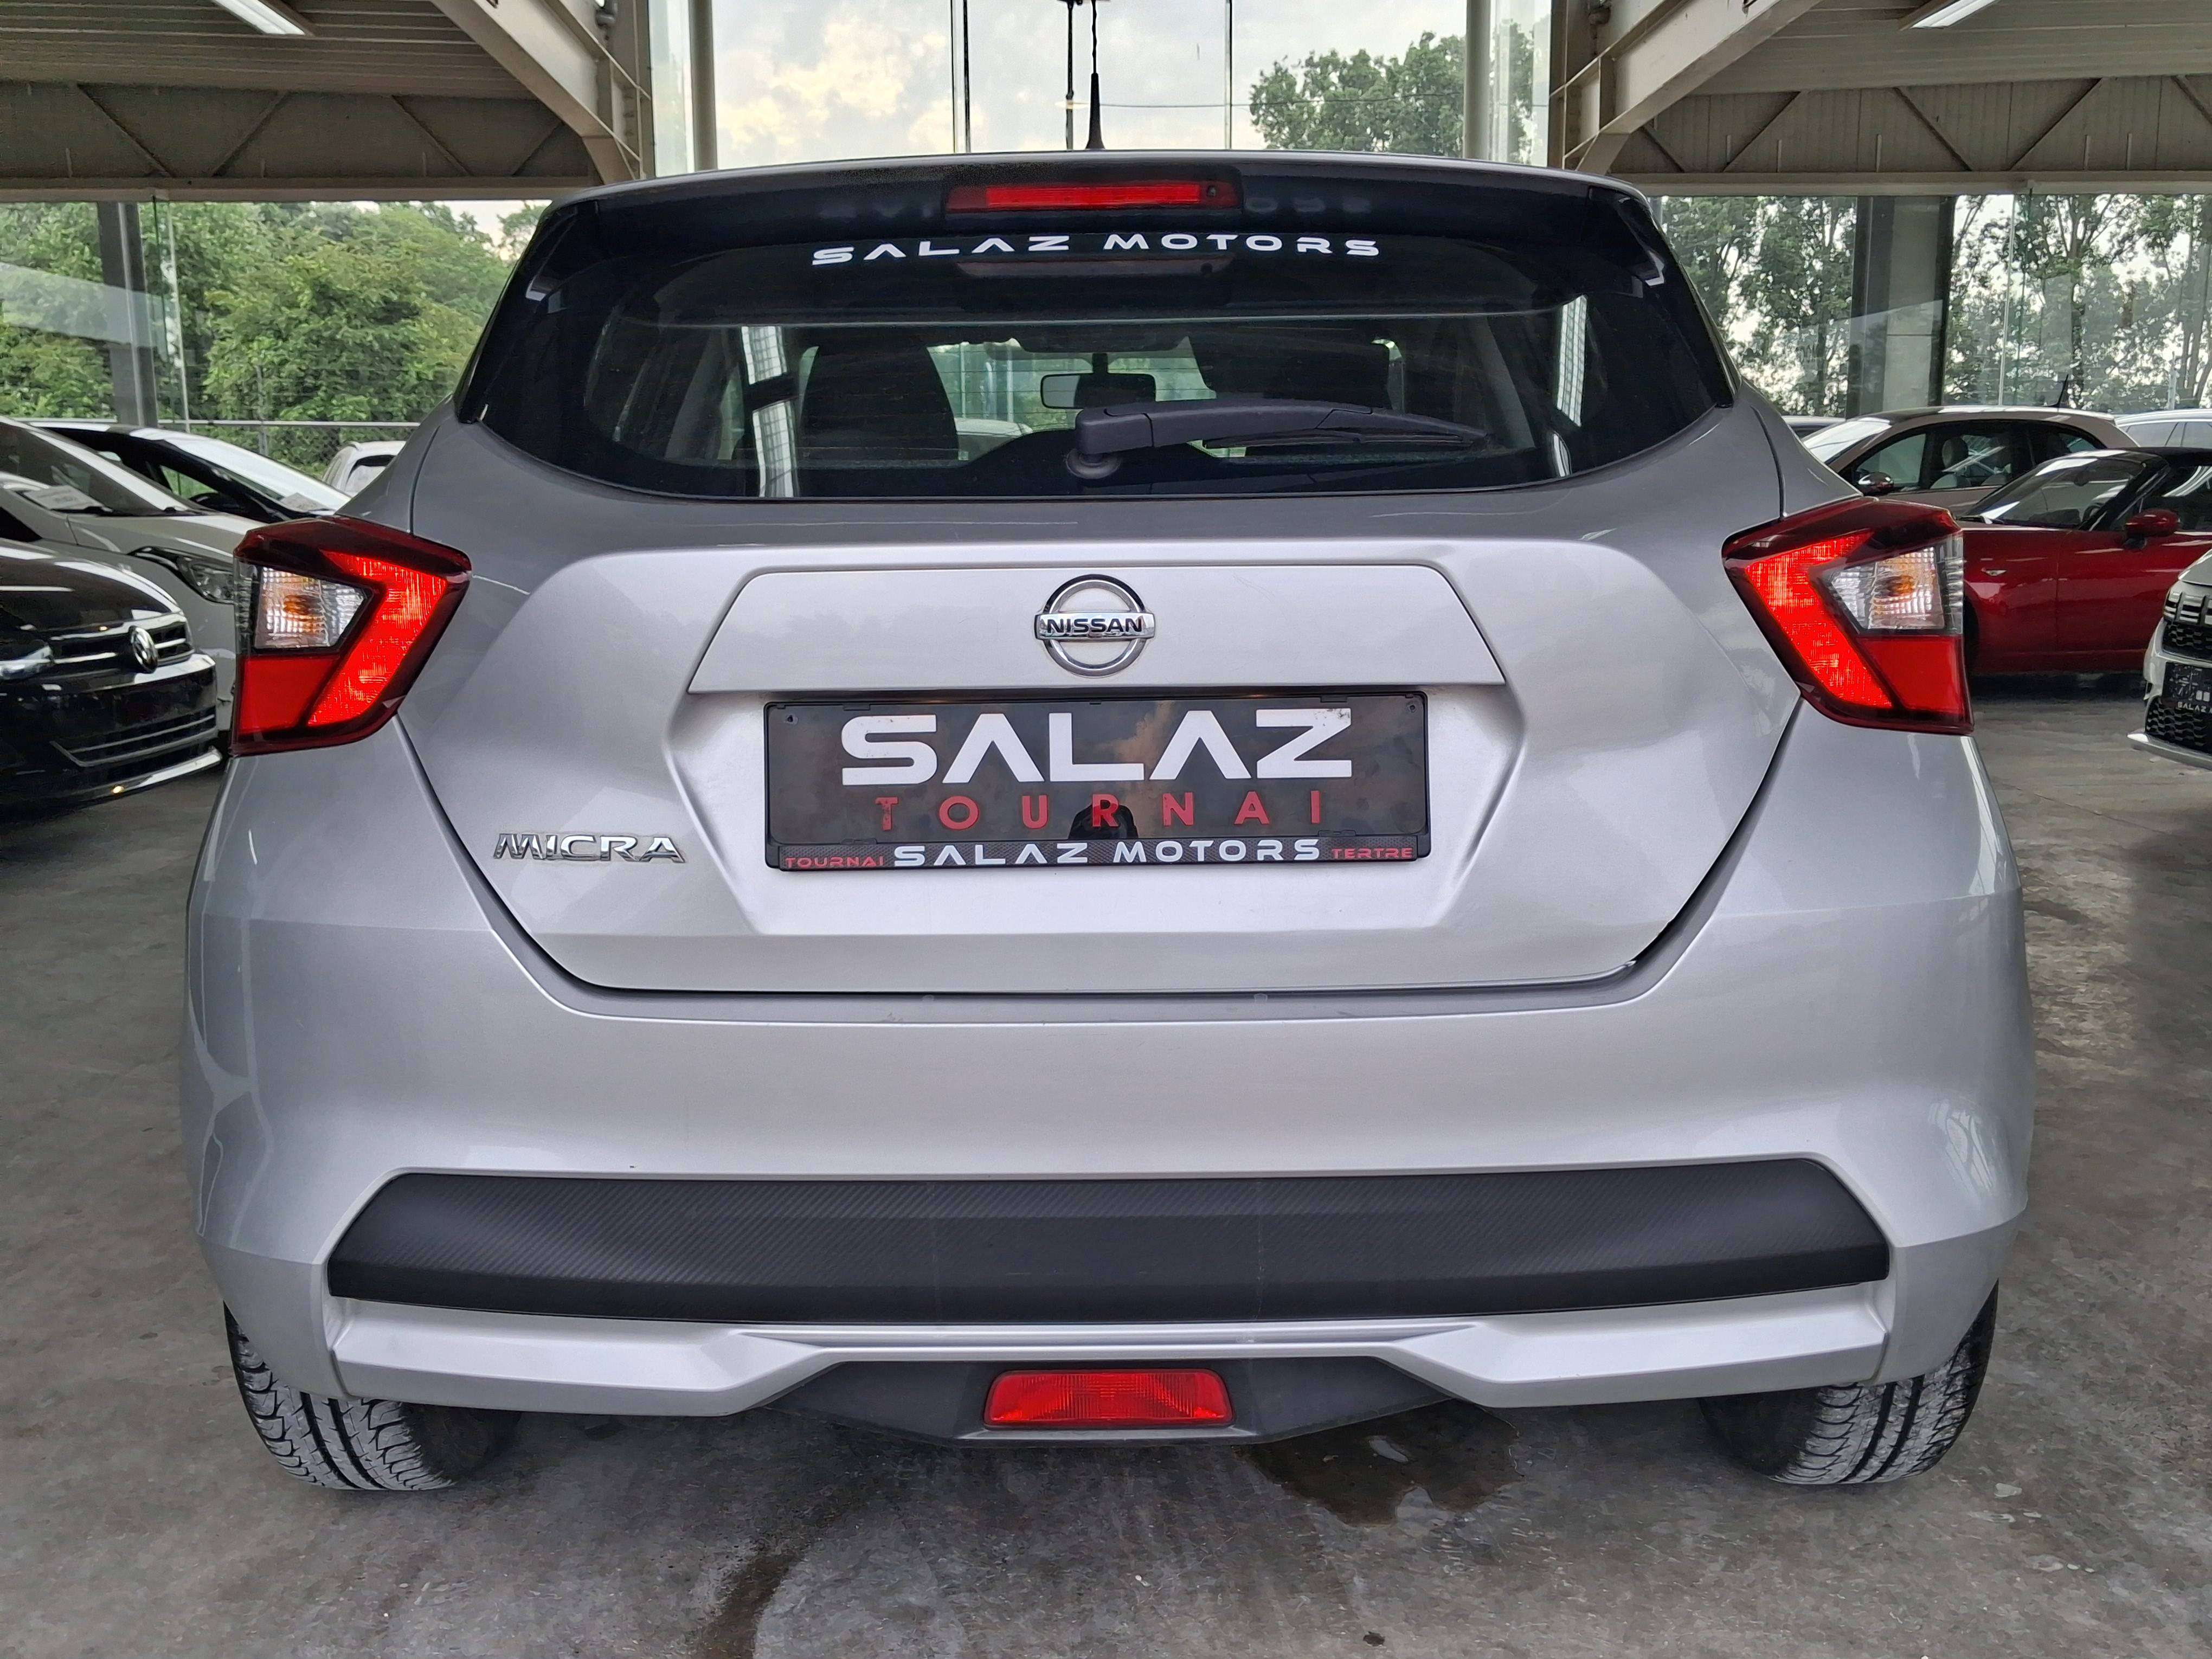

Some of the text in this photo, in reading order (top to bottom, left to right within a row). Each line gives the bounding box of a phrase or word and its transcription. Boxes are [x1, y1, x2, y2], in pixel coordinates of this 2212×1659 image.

[812, 234, 1380, 266] SALAZ MOTORS
[1046, 618, 1142, 634] NISSAN
[841, 708, 1352, 786] SALAZ
[876, 790, 1321, 831] TOURNAI
[493, 833, 686, 863] MICRA
[785, 839, 1413, 868] TOURNAI SALAZ MOTORS TERTRE
